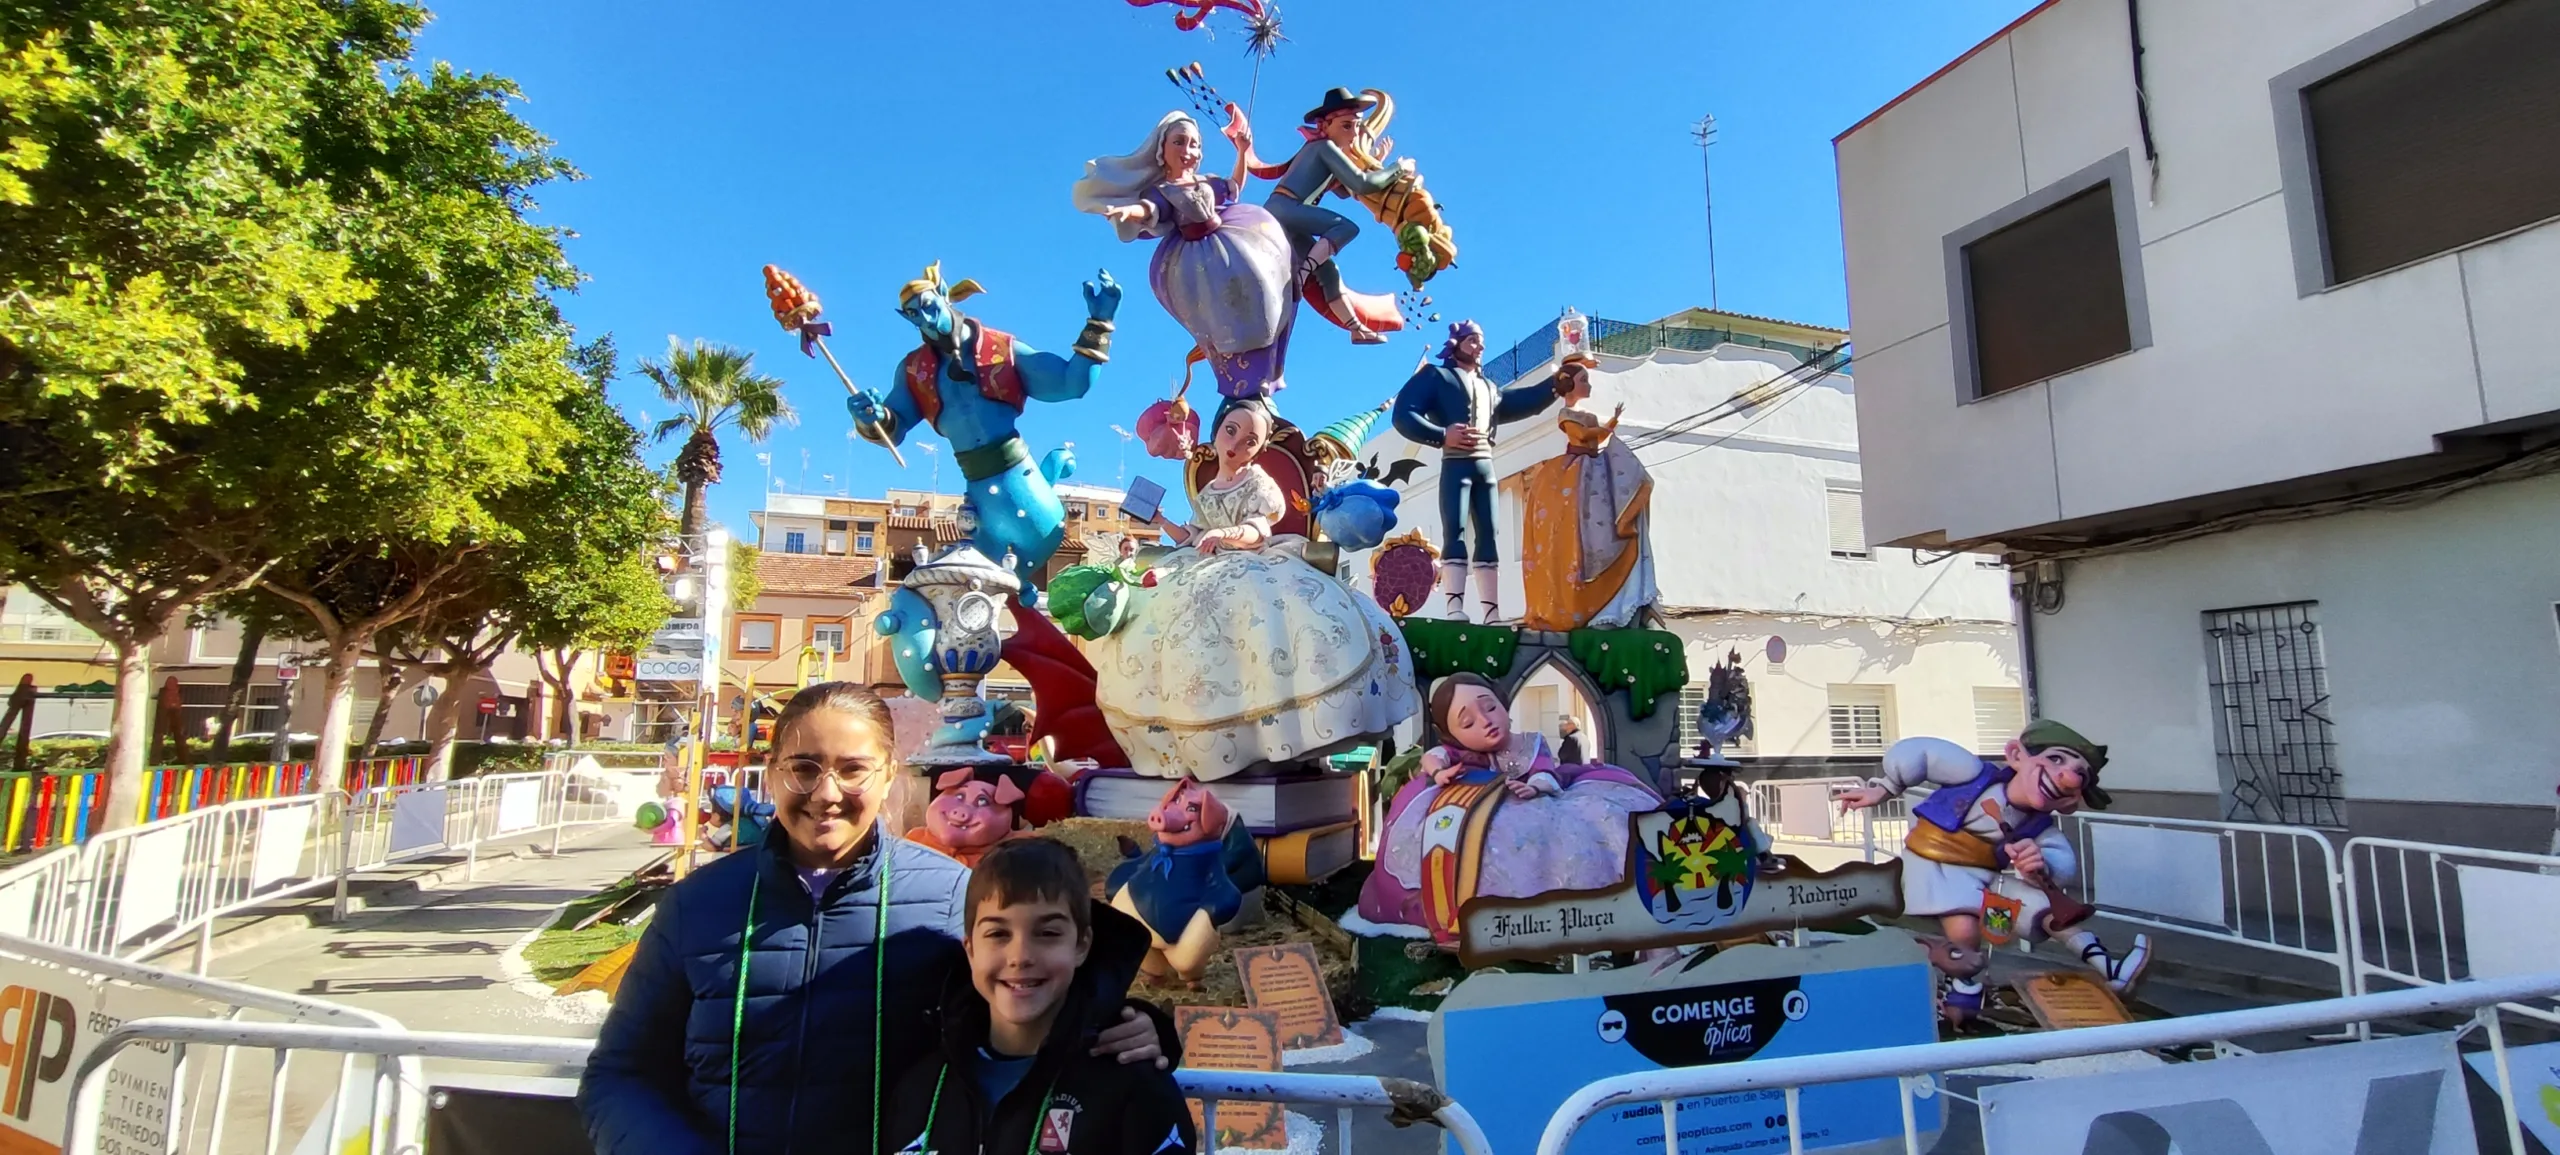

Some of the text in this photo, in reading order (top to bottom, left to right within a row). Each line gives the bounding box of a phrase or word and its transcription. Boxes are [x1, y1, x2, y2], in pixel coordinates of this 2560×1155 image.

[640, 661, 700, 674] COCOA
[1558, 907, 1614, 937] Plaça
[1787, 884, 1857, 910] Rodrigo
[1651, 996, 1755, 1024] COMENGE
[1703, 1014, 1753, 1055] ópticos
[1612, 1112, 1618, 1122] y
[1687, 1101, 1700, 1110] en
[1704, 1094, 1740, 1108] Puerto
[1743, 1091, 1757, 1102] de
[1745, 1138, 1768, 1149] Camp
[1769, 1136, 1780, 1145] de
